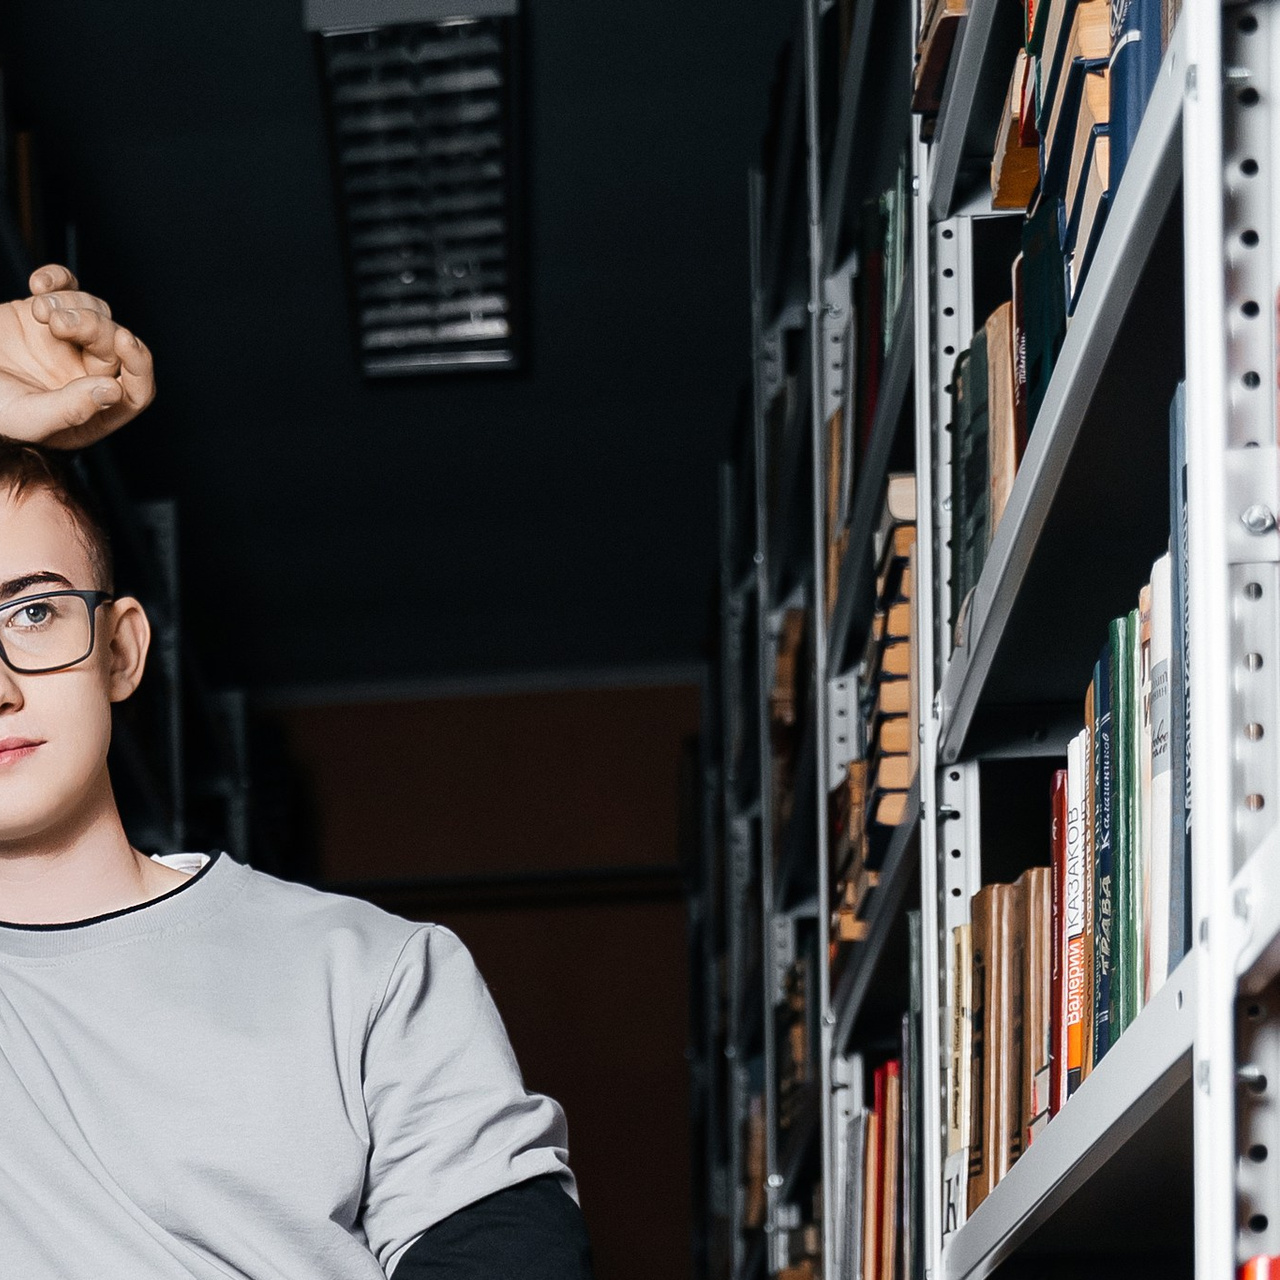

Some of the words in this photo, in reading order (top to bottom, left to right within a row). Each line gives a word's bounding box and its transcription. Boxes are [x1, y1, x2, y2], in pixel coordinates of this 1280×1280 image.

[1099, 732, 1111, 851] Калашников
[1067, 807, 1080, 934] КАЗАКОВ
[1101, 874, 1111, 976] ТРАВА
[1067, 941, 1080, 1027] Валерий
